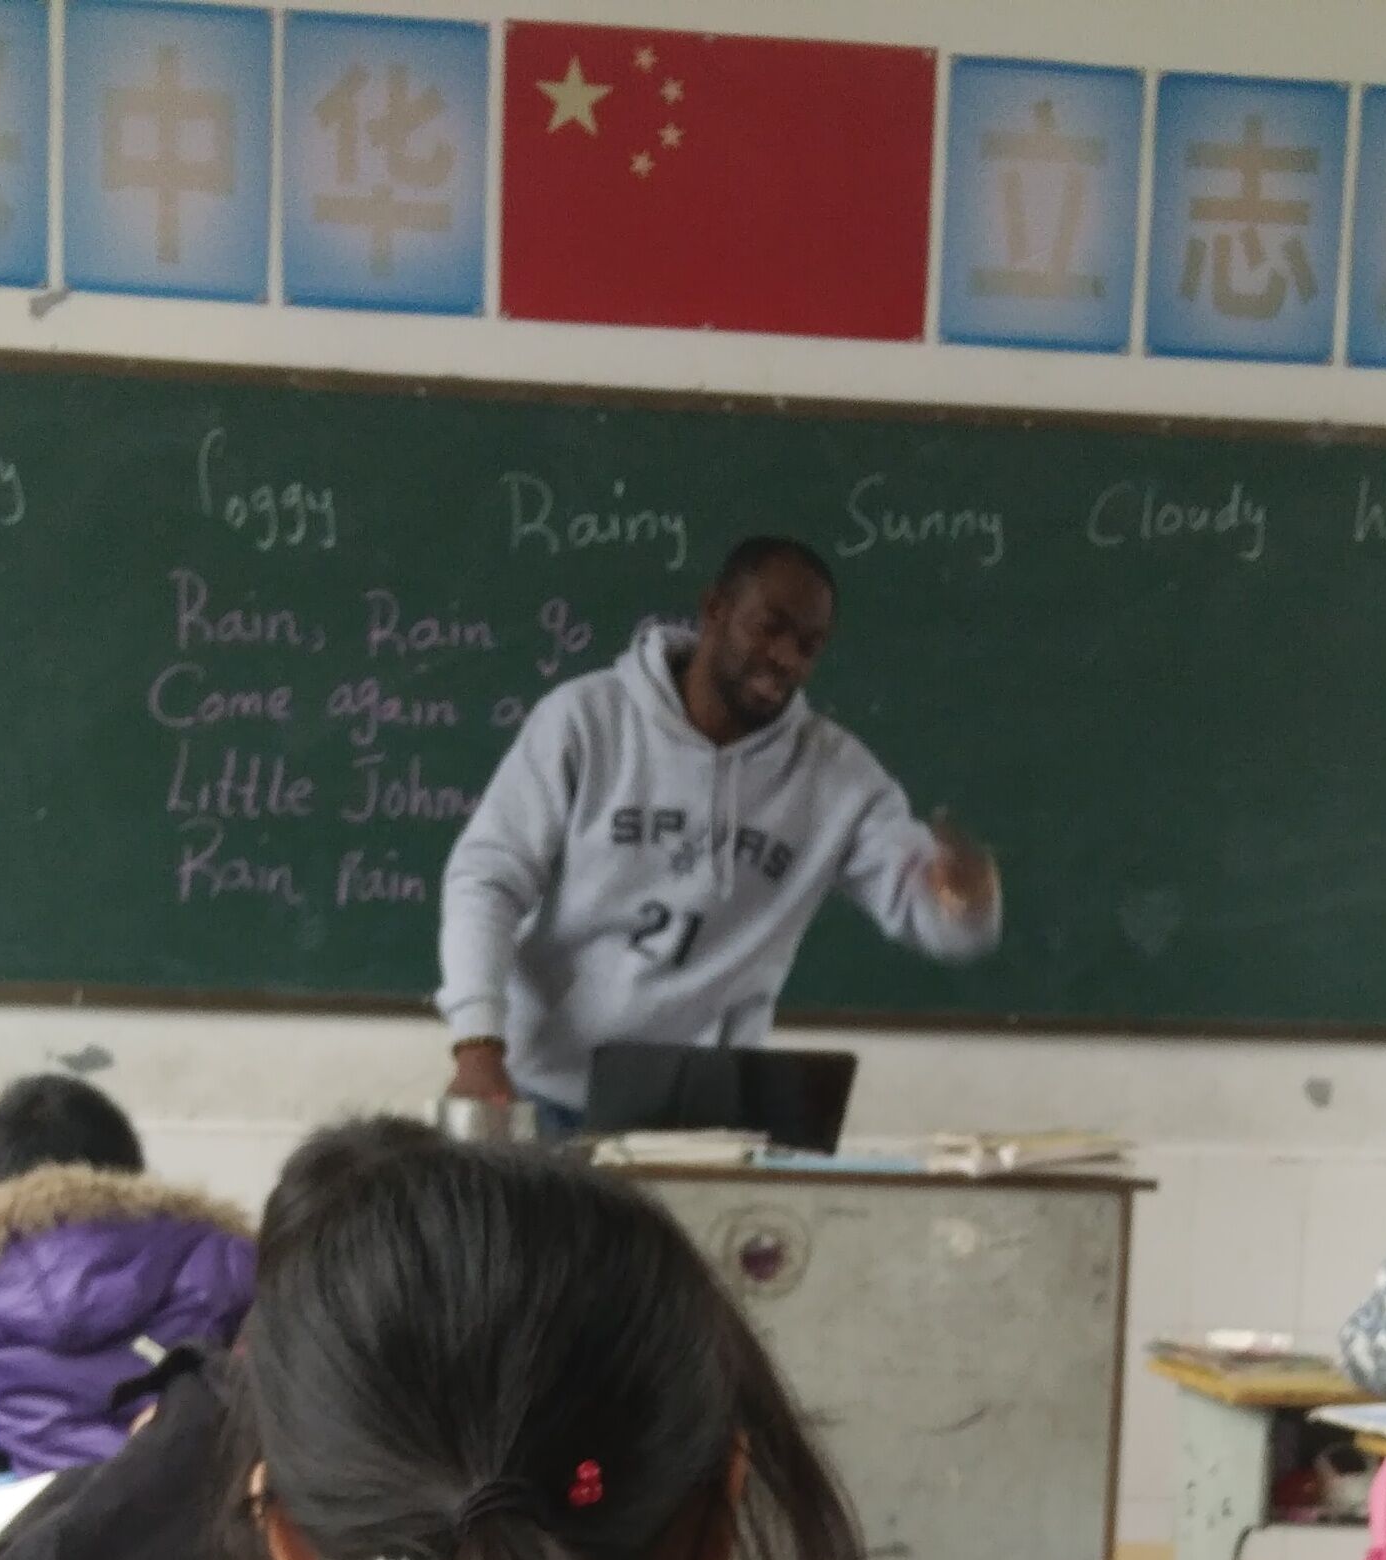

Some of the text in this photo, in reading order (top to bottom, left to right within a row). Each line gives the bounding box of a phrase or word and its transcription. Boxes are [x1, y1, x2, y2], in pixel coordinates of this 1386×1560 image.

[500, 470, 688, 572] Rainy
[835, 471, 1006, 568] Sunny
[1086, 478, 1269, 562] Cloudy
[169, 566, 594, 678] Rain, Rain go
[149, 662, 294, 728] Come
[326, 664, 459, 747] again
[165, 739, 315, 821] Little
[629, 897, 703, 967] 21
